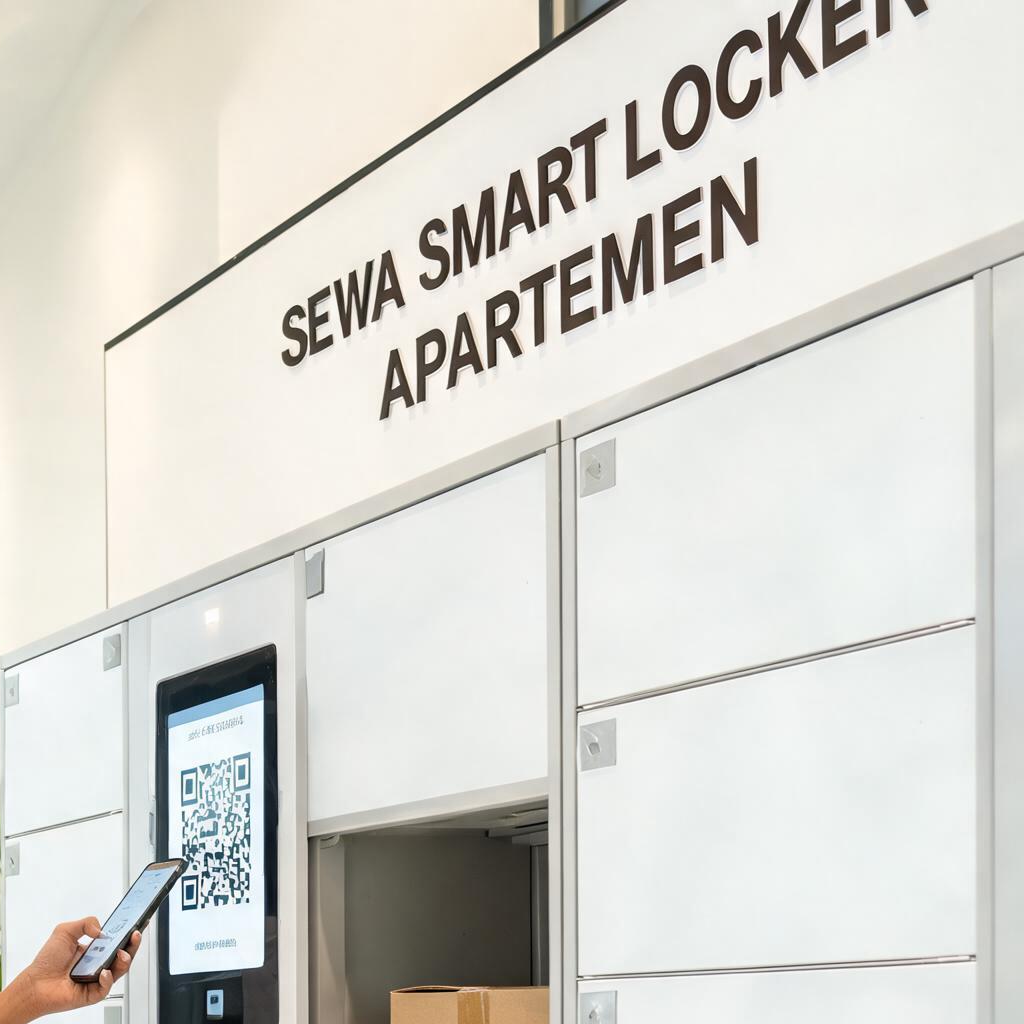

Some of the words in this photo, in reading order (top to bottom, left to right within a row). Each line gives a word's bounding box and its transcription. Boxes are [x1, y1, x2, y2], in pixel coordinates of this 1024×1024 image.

[281, 250, 405, 366] SEWA
[419, 118, 607, 290] SMART
[379, 157, 759, 420] APARTEMEN
